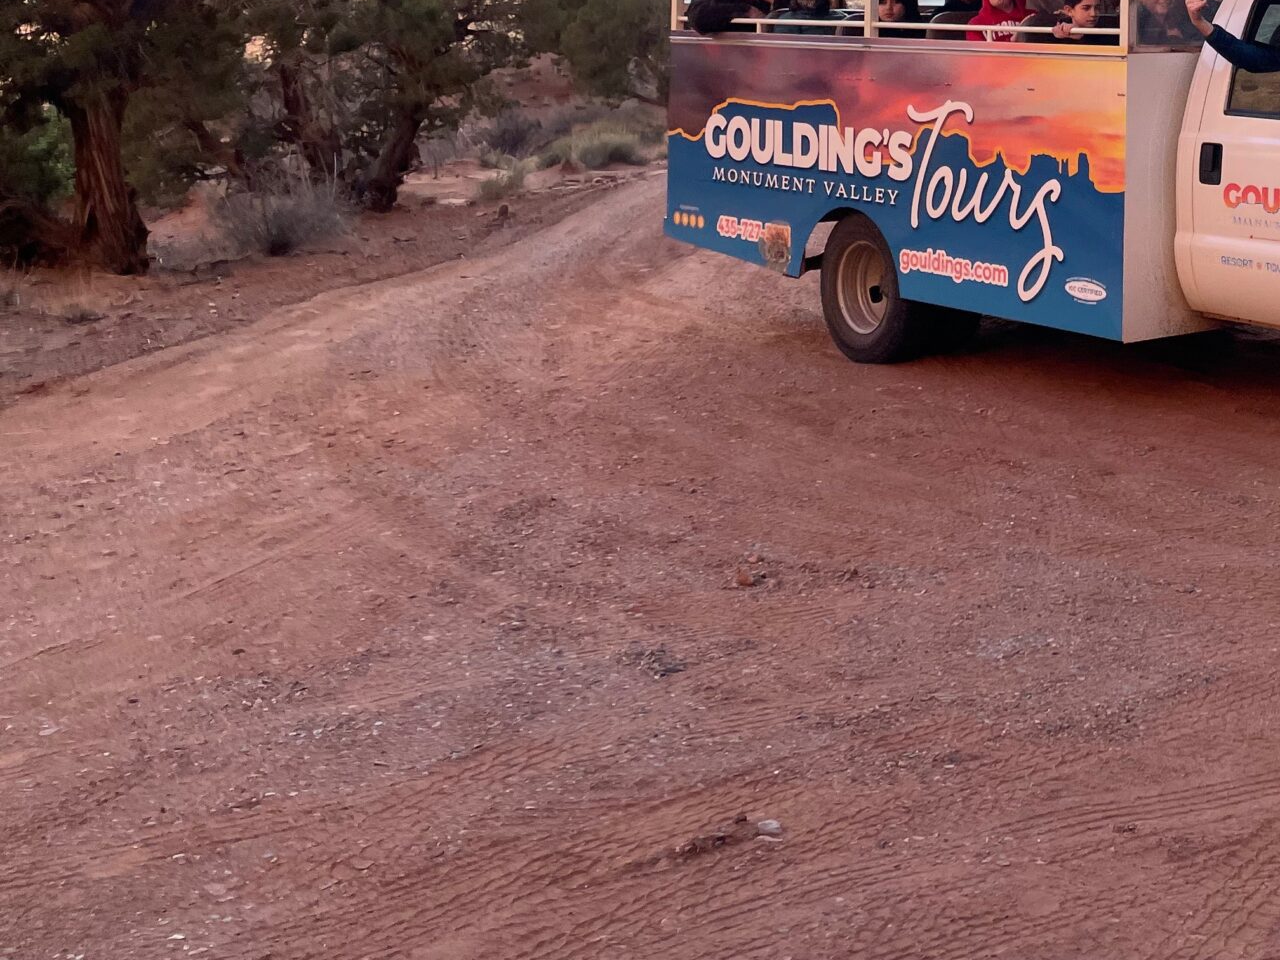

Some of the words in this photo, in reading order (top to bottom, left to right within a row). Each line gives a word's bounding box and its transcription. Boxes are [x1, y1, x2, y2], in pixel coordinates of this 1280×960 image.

[705, 114, 913, 181] GOULDING'S
[712, 167, 815, 194] MONUMENT
[824, 181, 899, 205] VALLEY
[907, 100, 1065, 302] Tours
[900, 249, 1008, 285] gouldings.com
[1220, 255, 1253, 269] RESORT
